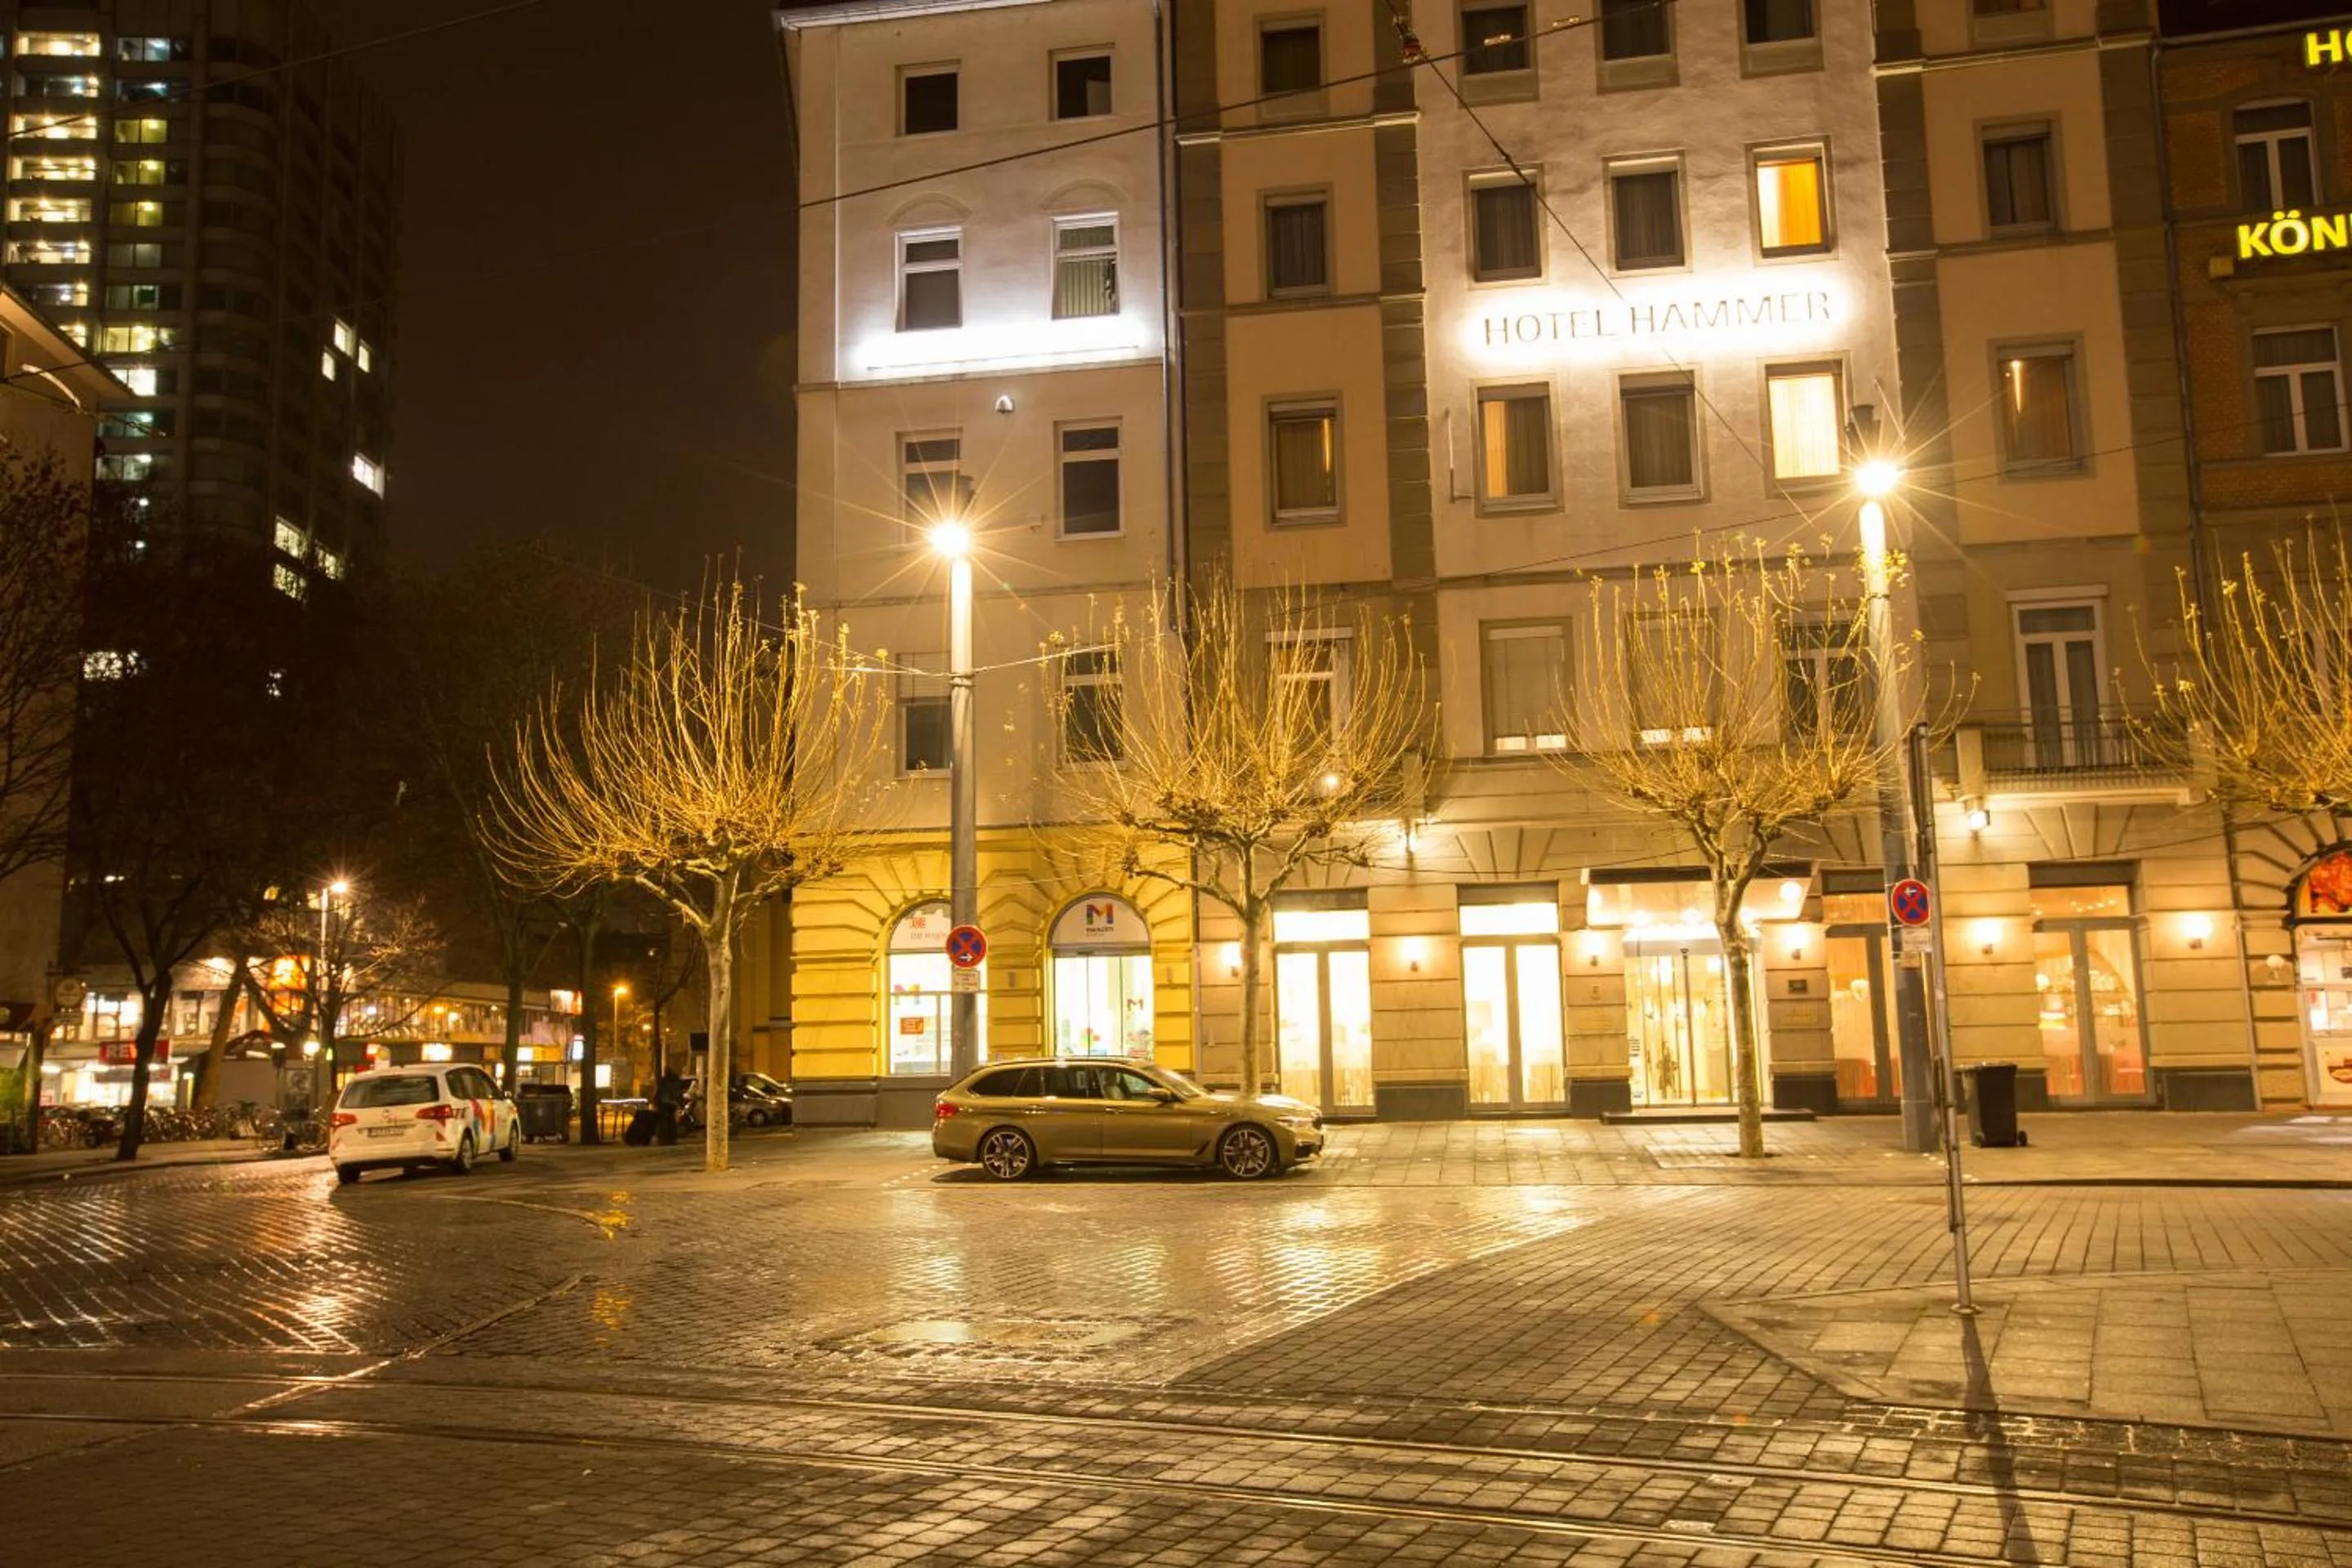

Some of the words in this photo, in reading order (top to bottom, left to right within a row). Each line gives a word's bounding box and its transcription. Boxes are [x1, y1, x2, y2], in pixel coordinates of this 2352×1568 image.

[2306, 29, 2352, 65] H
[1485, 309, 1618, 345] HOTEL
[1630, 292, 1829, 335] HAMMER
